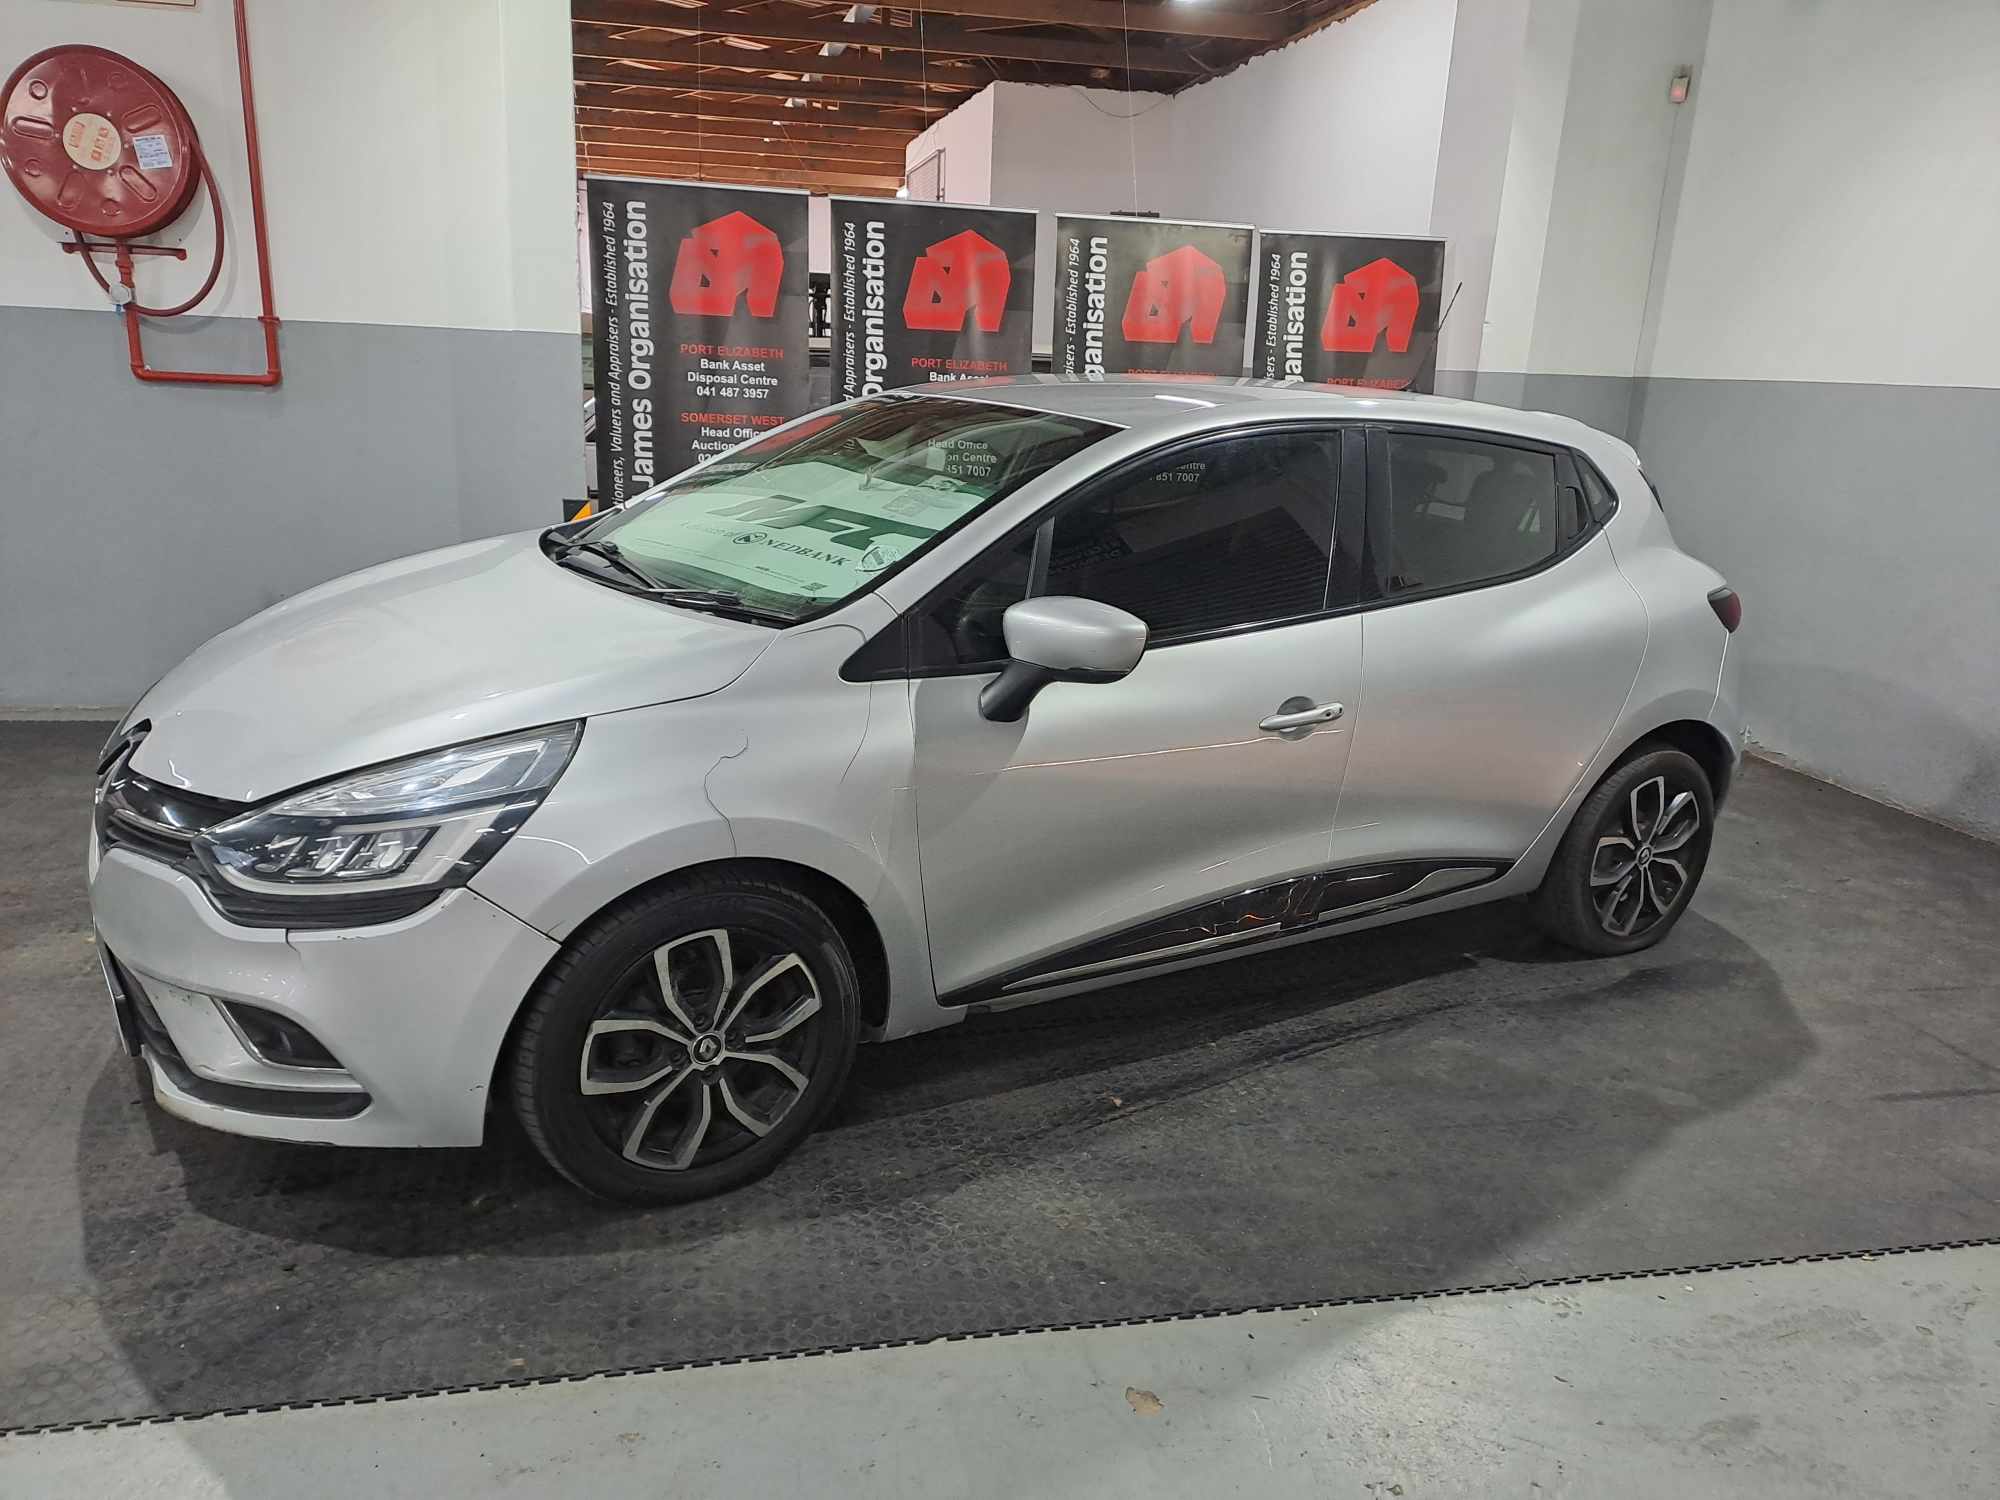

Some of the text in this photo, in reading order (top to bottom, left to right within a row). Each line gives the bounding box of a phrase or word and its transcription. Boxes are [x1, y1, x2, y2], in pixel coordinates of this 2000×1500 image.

[602, 201, 615, 232] 1964
[843, 222, 856, 252] 1964
[1068, 238, 1081, 266] 1964
[602, 235, 618, 306] Established
[1270, 253, 1281, 281] 1964
[843, 253, 856, 322] Established
[1065, 269, 1079, 335] Established
[1265, 283, 1280, 347] Established
[606, 316, 622, 381] Appraisers
[623, 200, 655, 489] James Organisation
[680, 343, 785, 358] PORT ELIZABETH
[700, 358, 765, 372] Bank Asset
[843, 331, 857, 391] Appraisers
[911, 357, 1008, 371] PORT ELIZABETH
[687, 371, 778, 386] Disposal Centre
[929, 371, 957, 382] Bank
[608, 381, 622, 409] and
[696, 386, 769, 399] 041 487 3957
[609, 408, 623, 452] Valuers
[680, 412, 785, 426] SOMERSET WEST
[701, 426, 730, 438] Head
[928, 439, 955, 449] Head
[962, 452, 998, 463] Centre
[967, 465, 991, 477] 7007
[1176, 472, 1200, 482] 7007
[762, 537, 852, 567] NEDBANK
